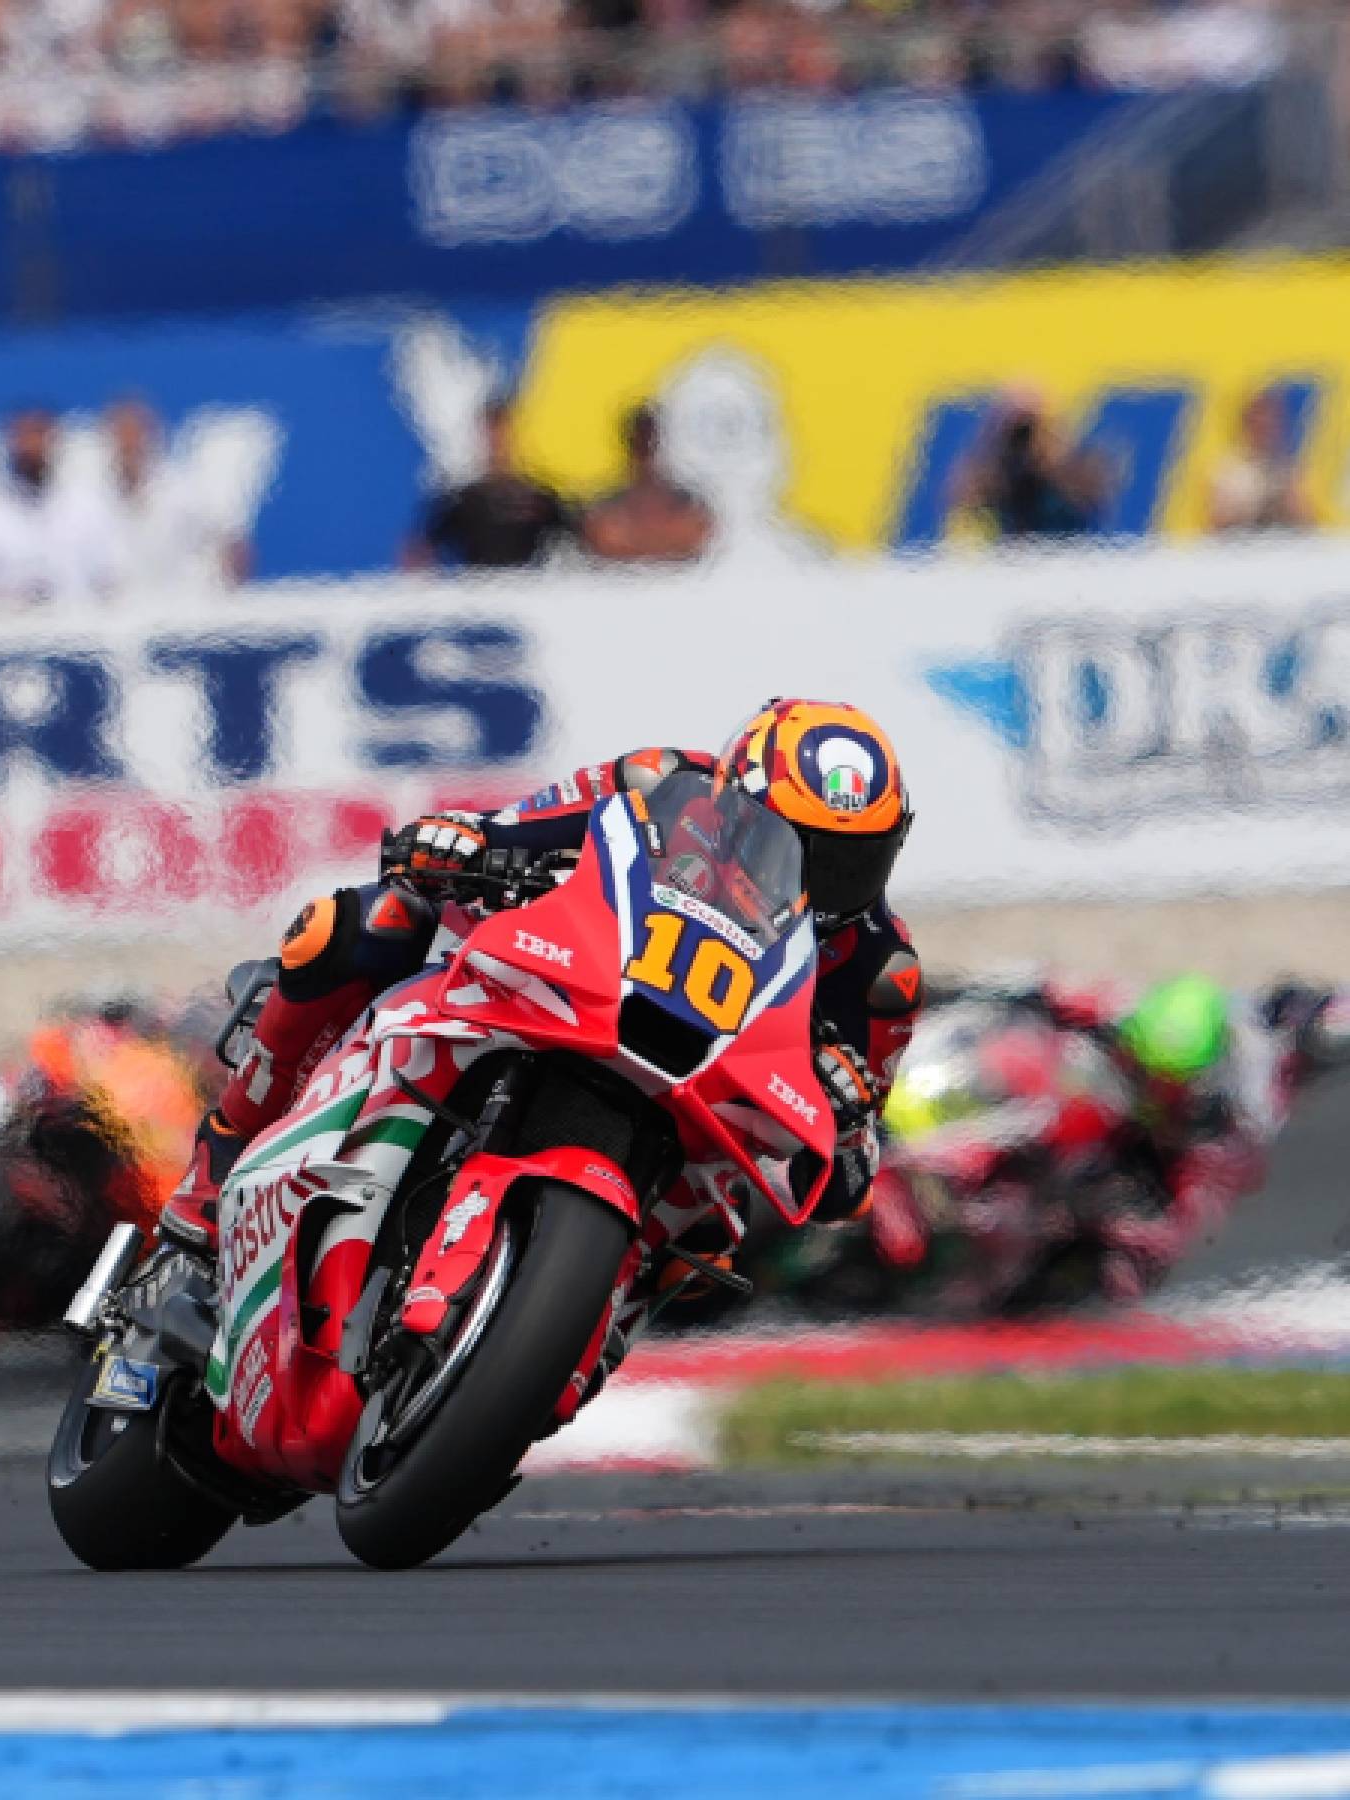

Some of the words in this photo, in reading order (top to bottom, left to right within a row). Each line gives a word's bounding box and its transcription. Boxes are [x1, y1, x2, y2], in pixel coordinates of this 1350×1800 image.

[512, 929, 573, 968] IBM
[625, 911, 756, 1037] 10
[766, 1073, 819, 1126] IBM
